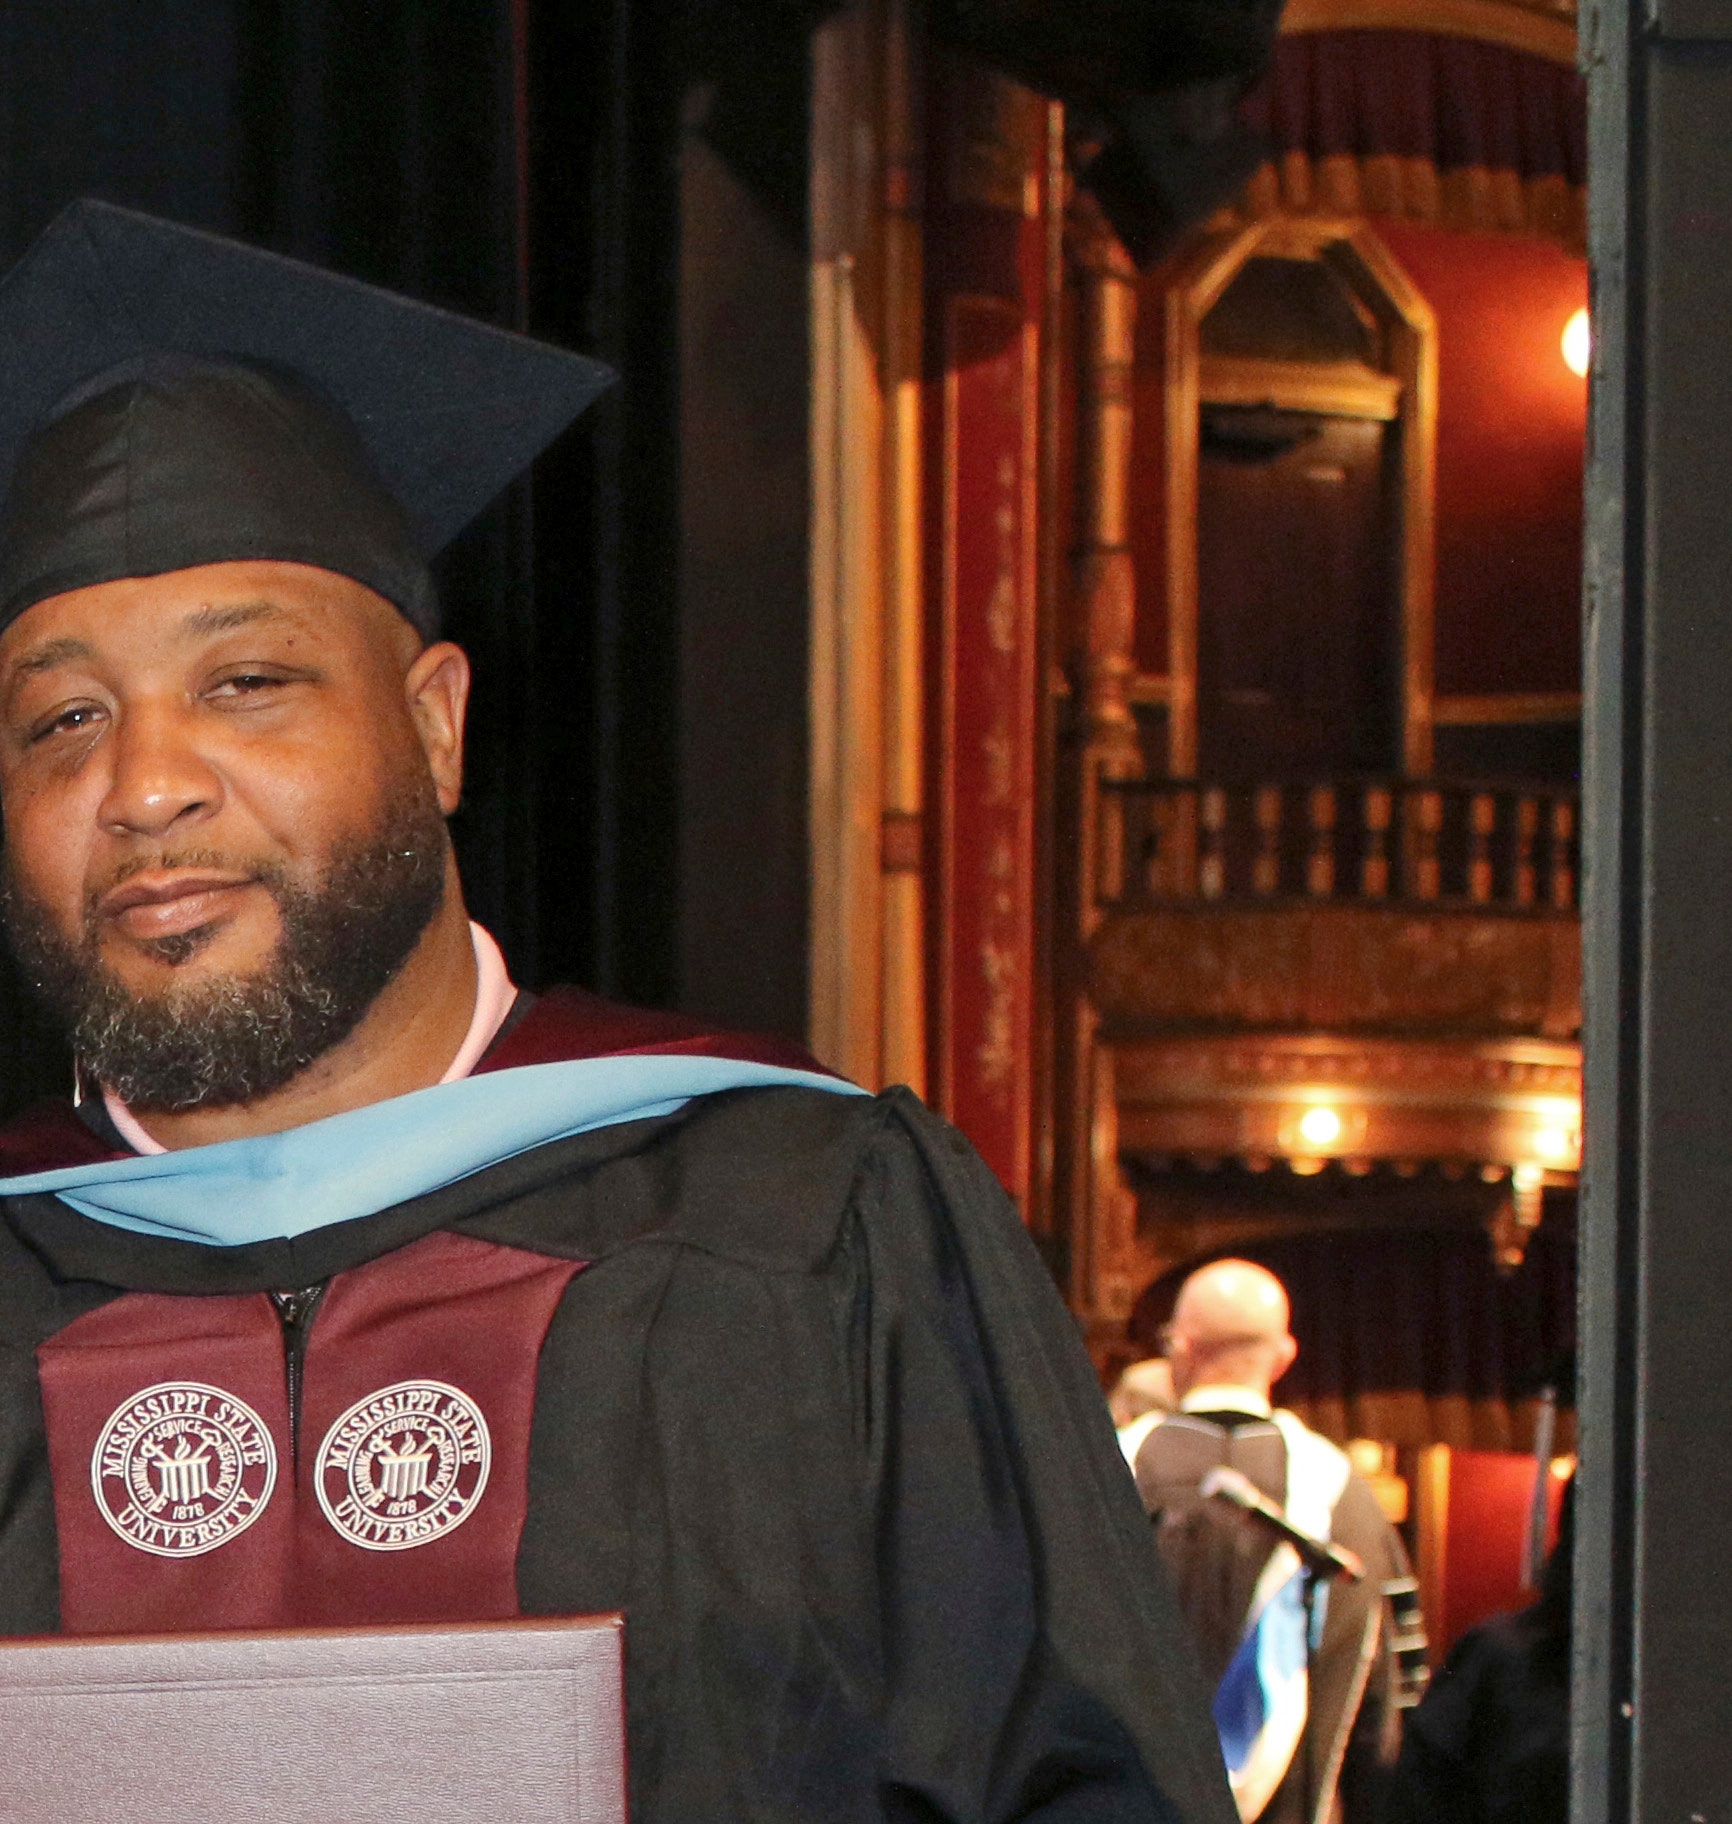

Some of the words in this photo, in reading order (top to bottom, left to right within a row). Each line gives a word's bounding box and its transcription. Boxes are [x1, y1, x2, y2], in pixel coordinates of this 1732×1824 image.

[102, 1392, 211, 1478] MISSISSIPPI
[214, 1402, 266, 1466] STATE
[153, 1419, 202, 1441] SERVICE
[326, 1391, 442, 1470] MISSISSIPPI
[441, 1400, 481, 1464] STATE
[384, 1416, 430, 1437] SERVICE
[118, 1487, 258, 1547] UNIVERSITY
[173, 1503, 205, 1520] 1878
[336, 1487, 468, 1542] UNIVERSITY
[387, 1500, 417, 1515] 1878
